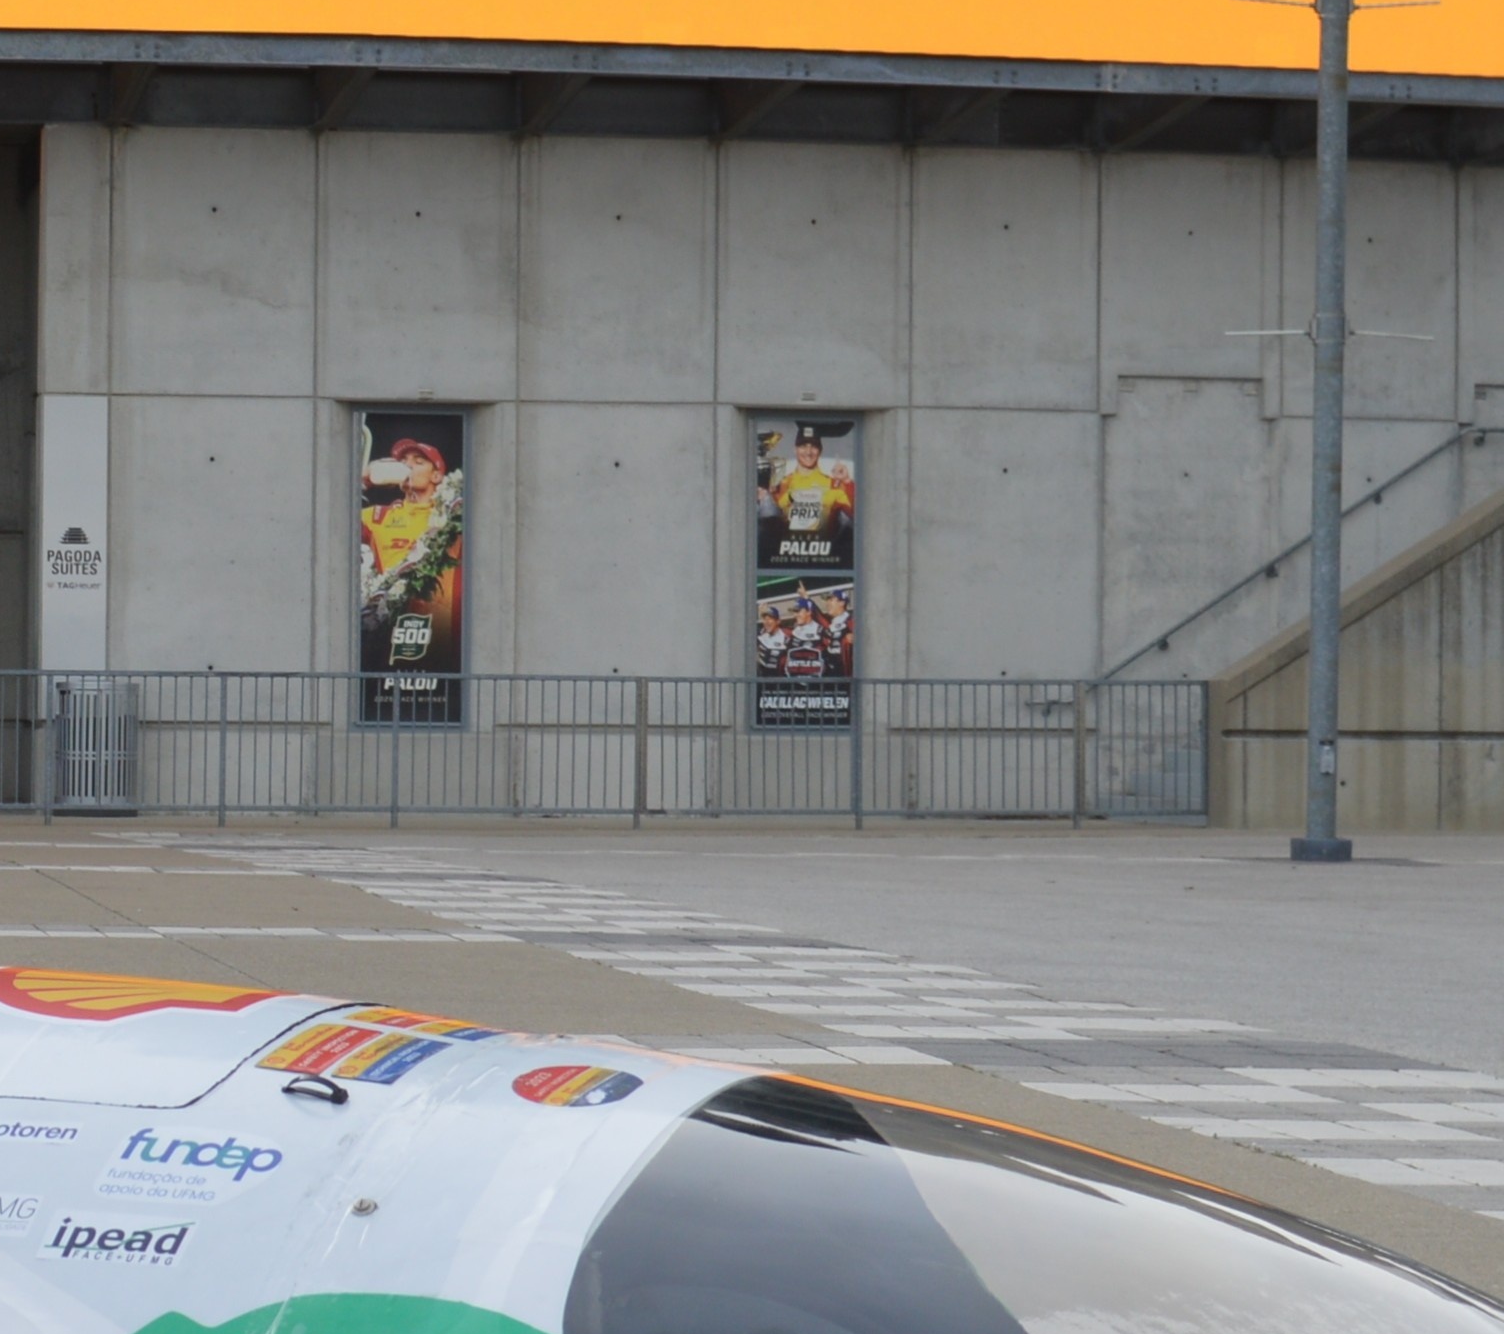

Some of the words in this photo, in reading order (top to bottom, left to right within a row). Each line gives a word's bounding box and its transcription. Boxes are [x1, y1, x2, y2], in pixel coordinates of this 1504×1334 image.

[790, 508, 820, 519] PRIX
[779, 541, 831, 555] PALOU
[47, 550, 102, 563] PAGODA
[51, 563, 98, 575] SUITES
[391, 628, 431, 644] 500
[120, 1127, 284, 1183] fundep
[98, 1181, 144, 1198] apoio
[146, 1185, 169, 1199] da
[171, 1188, 216, 1202] UFMG
[50, 1216, 190, 1259] ipead
